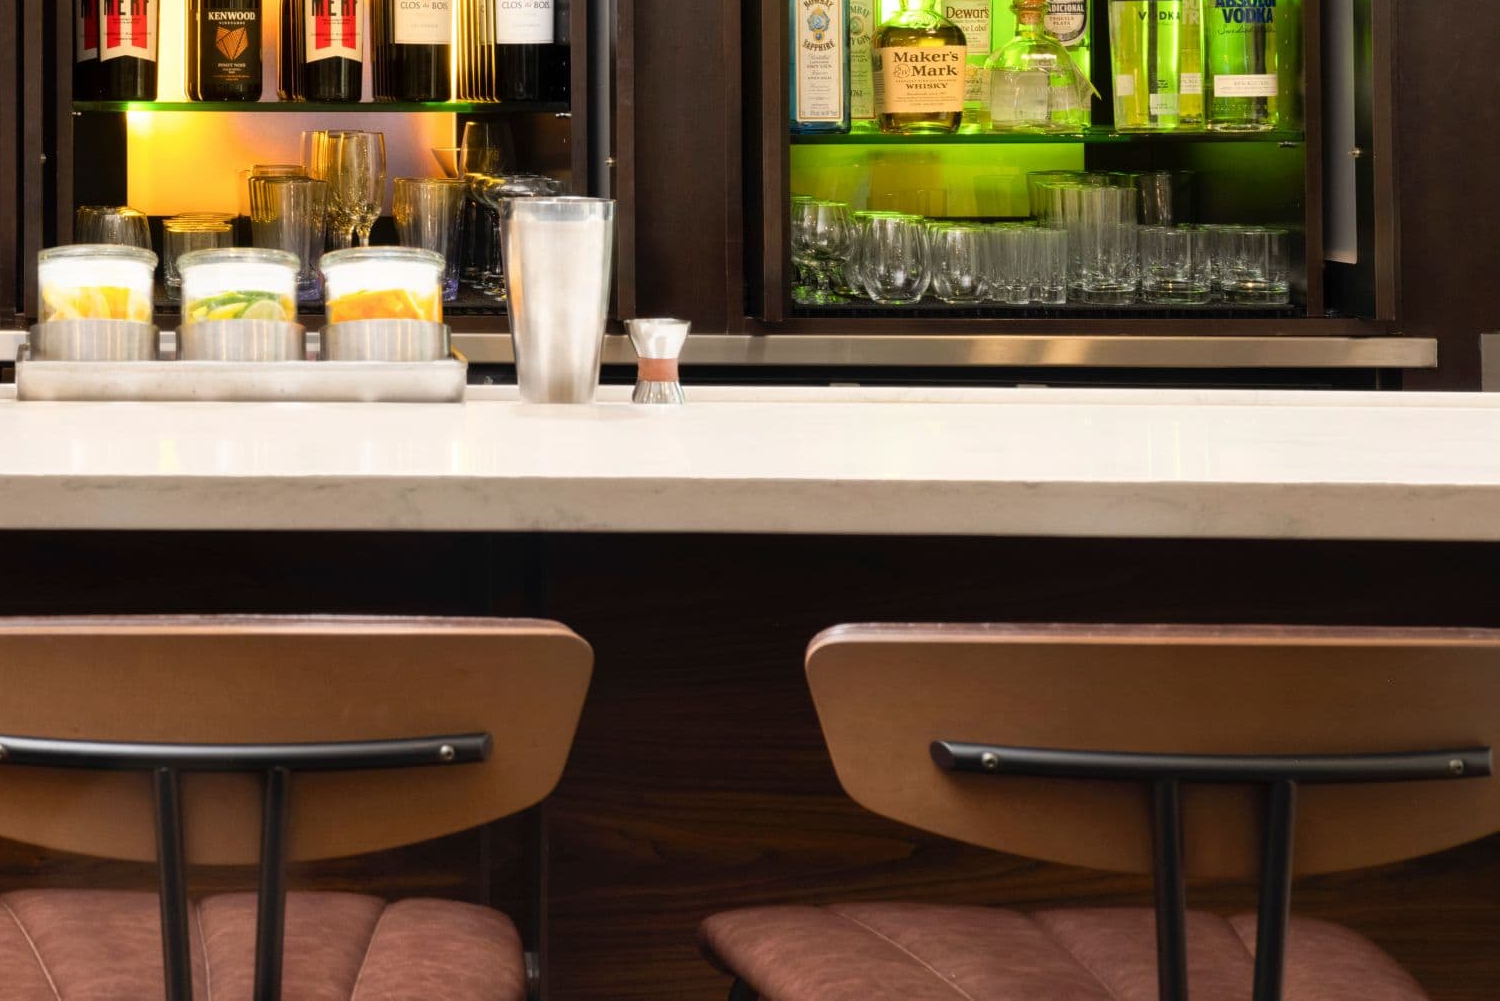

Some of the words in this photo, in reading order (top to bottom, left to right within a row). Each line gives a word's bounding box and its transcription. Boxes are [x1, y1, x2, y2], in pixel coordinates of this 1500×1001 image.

[400, 1, 421, 9] CLOS
[501, 1, 522, 9] CLOS
[534, 1, 550, 9] BOIS
[208, 11, 255, 21] KENWOOD
[850, 6, 870, 19] MBAY
[946, 6, 989, 19] Dewar's
[1223, 8, 1274, 25] VODKA
[971, 23, 987, 32] Label
[803, 39, 836, 52] SAPPHIRE
[893, 51, 959, 63] Maker's
[911, 65, 958, 76] Mark
